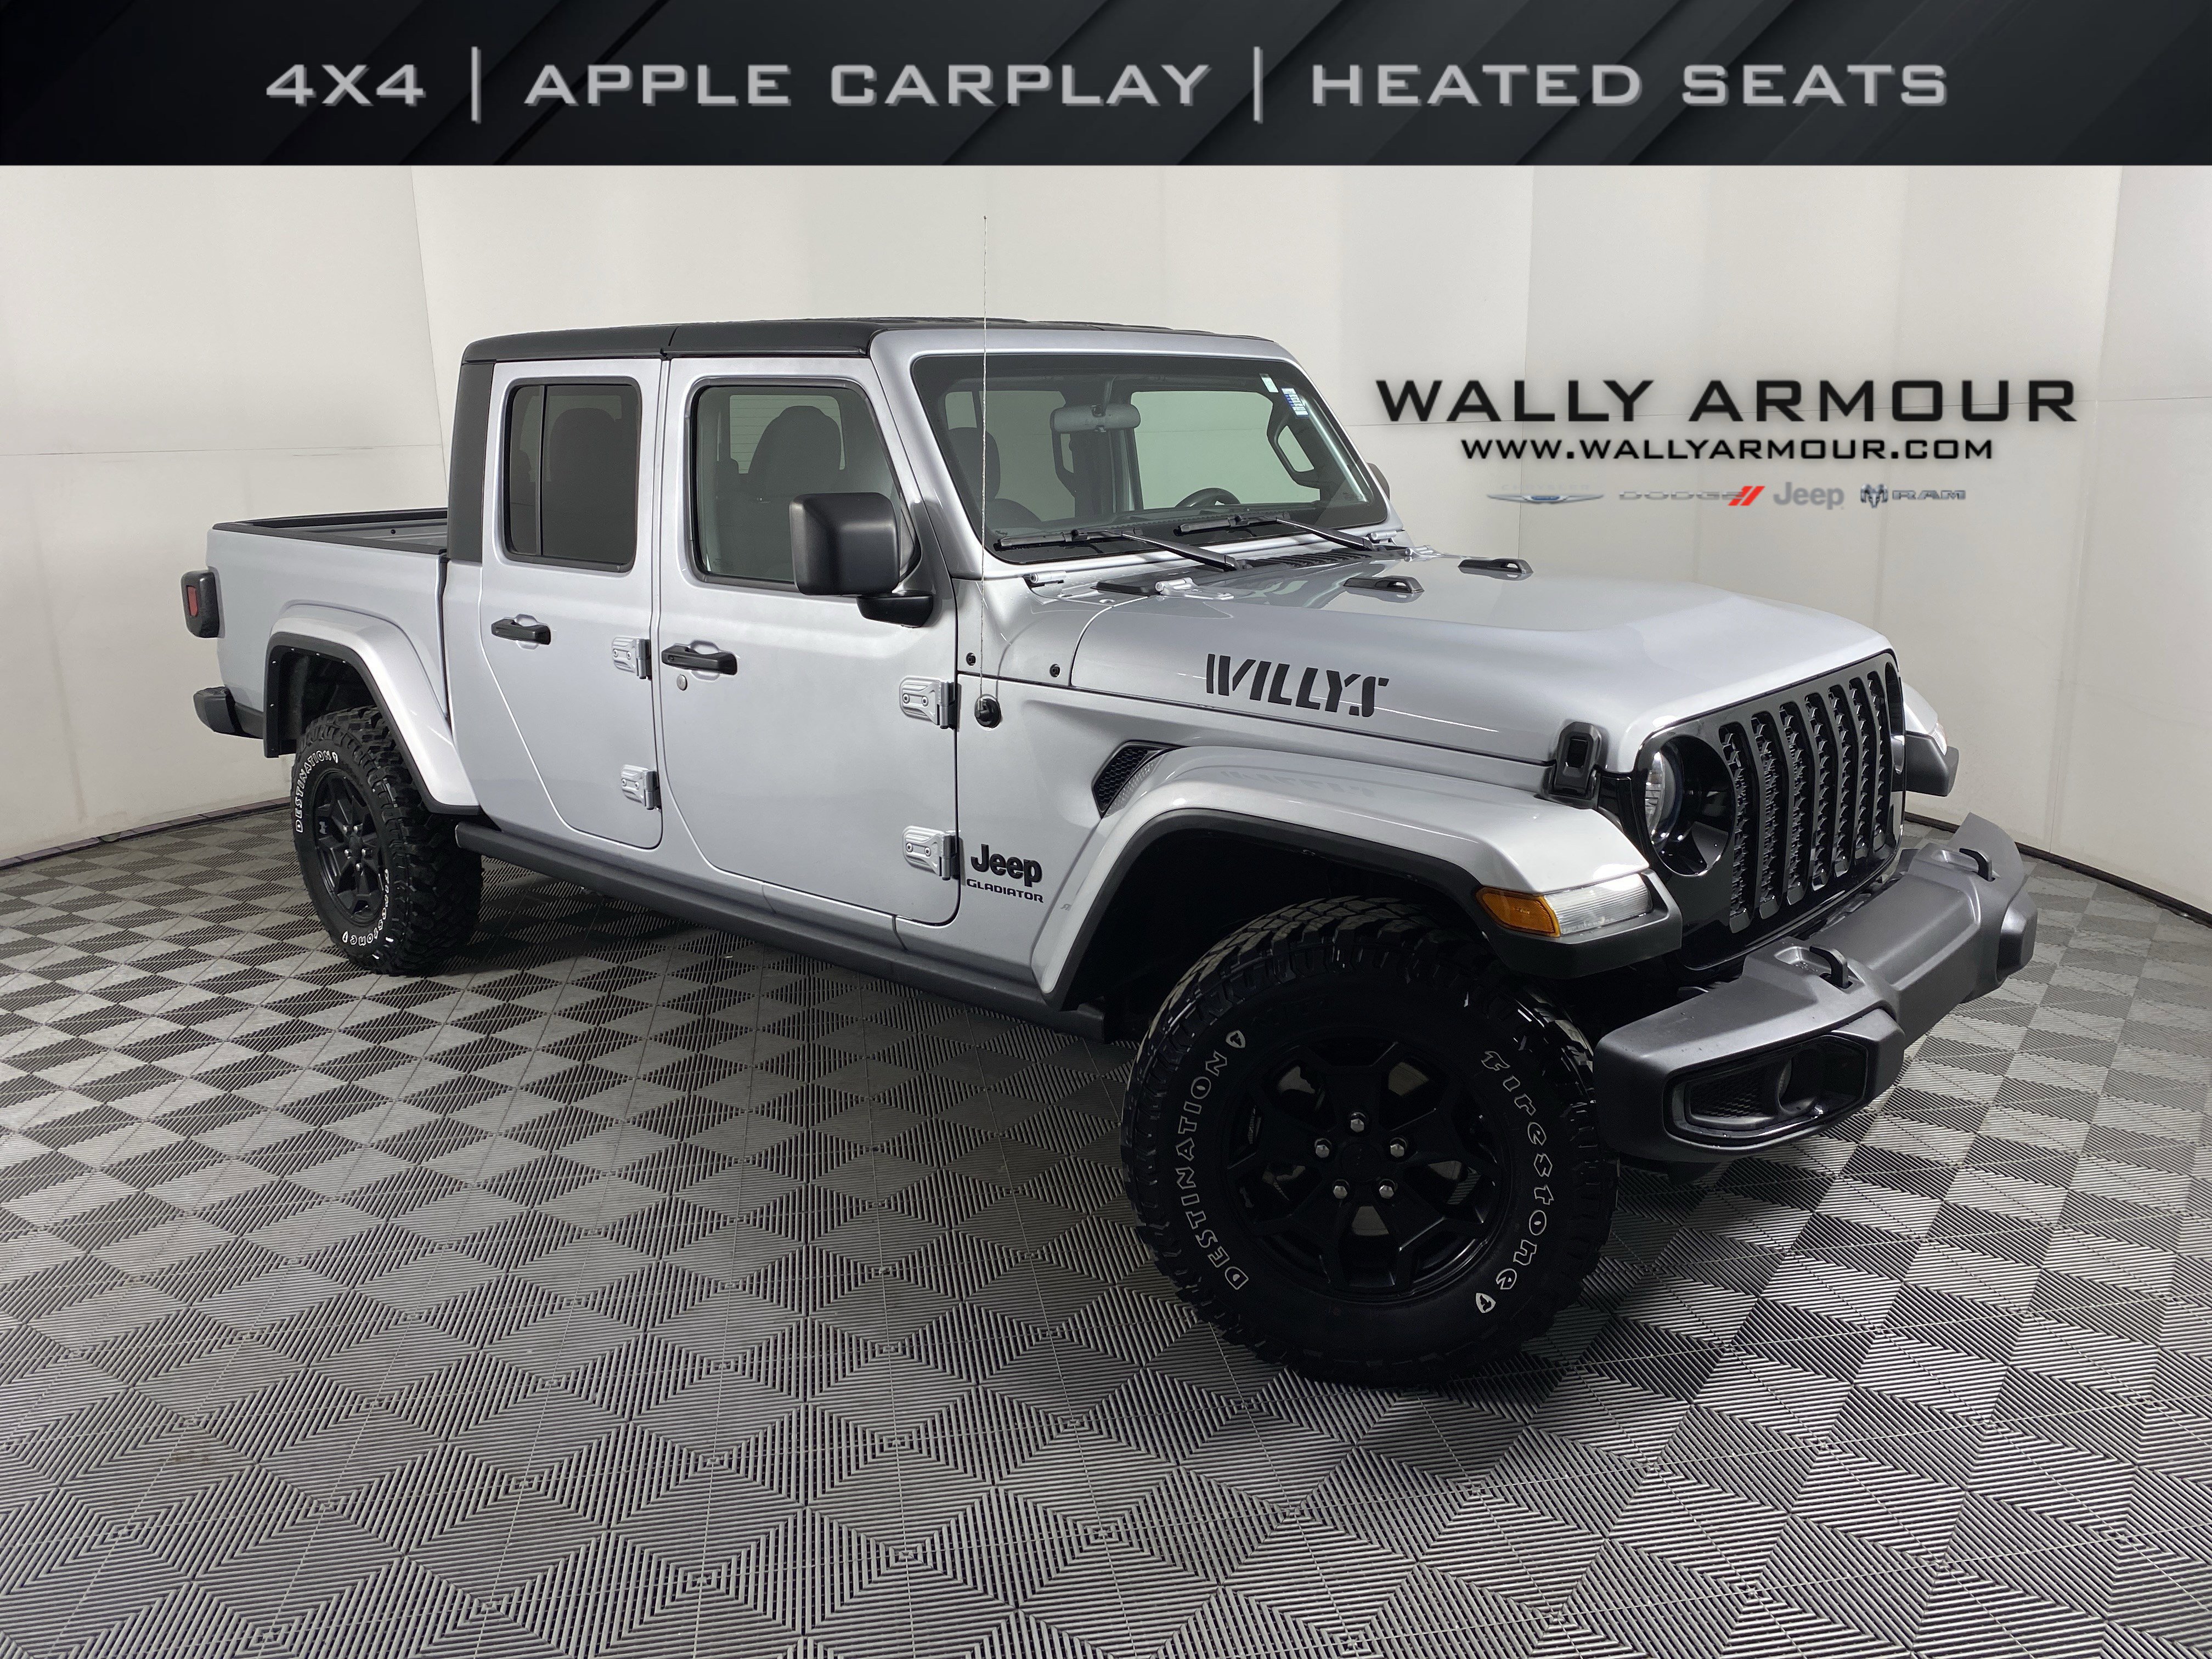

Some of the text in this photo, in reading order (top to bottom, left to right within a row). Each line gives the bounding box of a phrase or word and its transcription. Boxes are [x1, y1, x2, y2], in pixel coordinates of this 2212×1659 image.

[1206, 653, 1390, 718] WILLYS
[295, 750, 332, 833] DESTINATION
[966, 878, 1044, 903] GLADIATOR
[970, 843, 1042, 888] Jeep
[1175, 1050, 1249, 1290] DESTINATION
